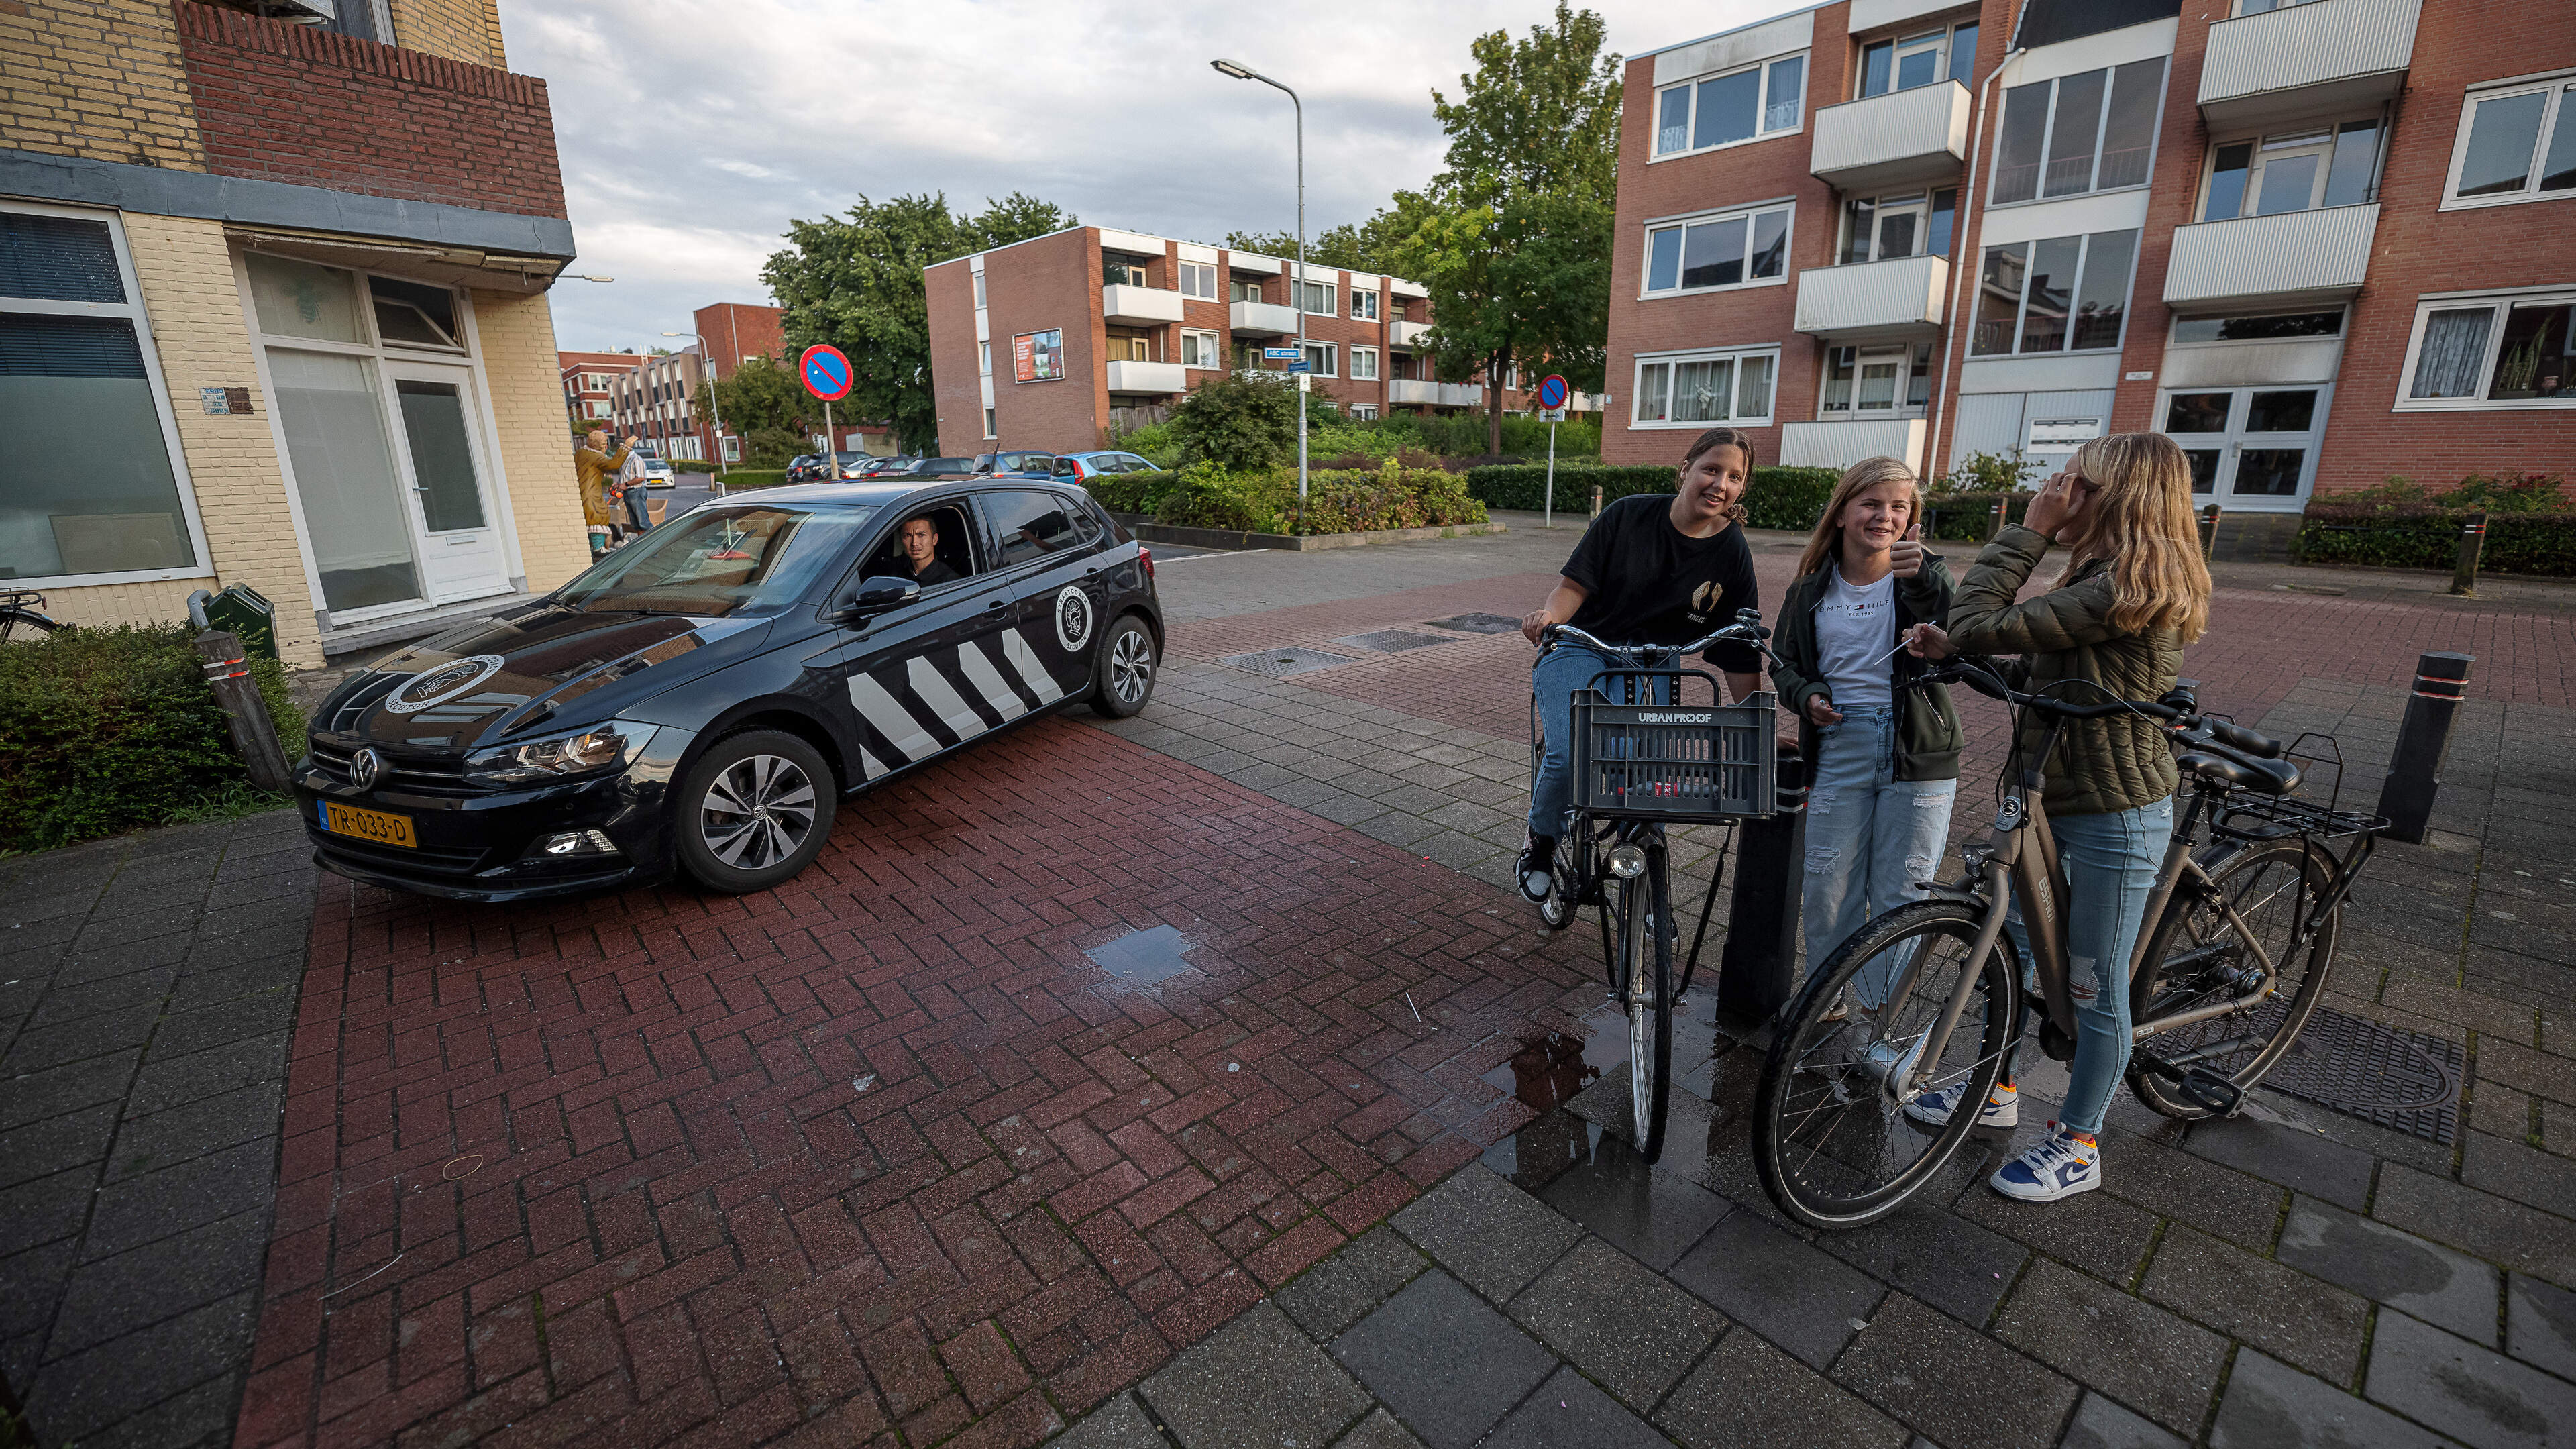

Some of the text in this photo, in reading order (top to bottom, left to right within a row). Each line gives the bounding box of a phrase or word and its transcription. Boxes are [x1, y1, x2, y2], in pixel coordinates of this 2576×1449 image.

[1058, 588, 1087, 613] STRAATCOACH
[1819, 604, 1851, 612] OMMY
[1066, 635, 1087, 650] SECUTOR
[437, 655, 500, 675] STRAATCOACH
[388, 698, 430, 712] SECUTOR
[329, 806, 407, 841] TR-033-D
